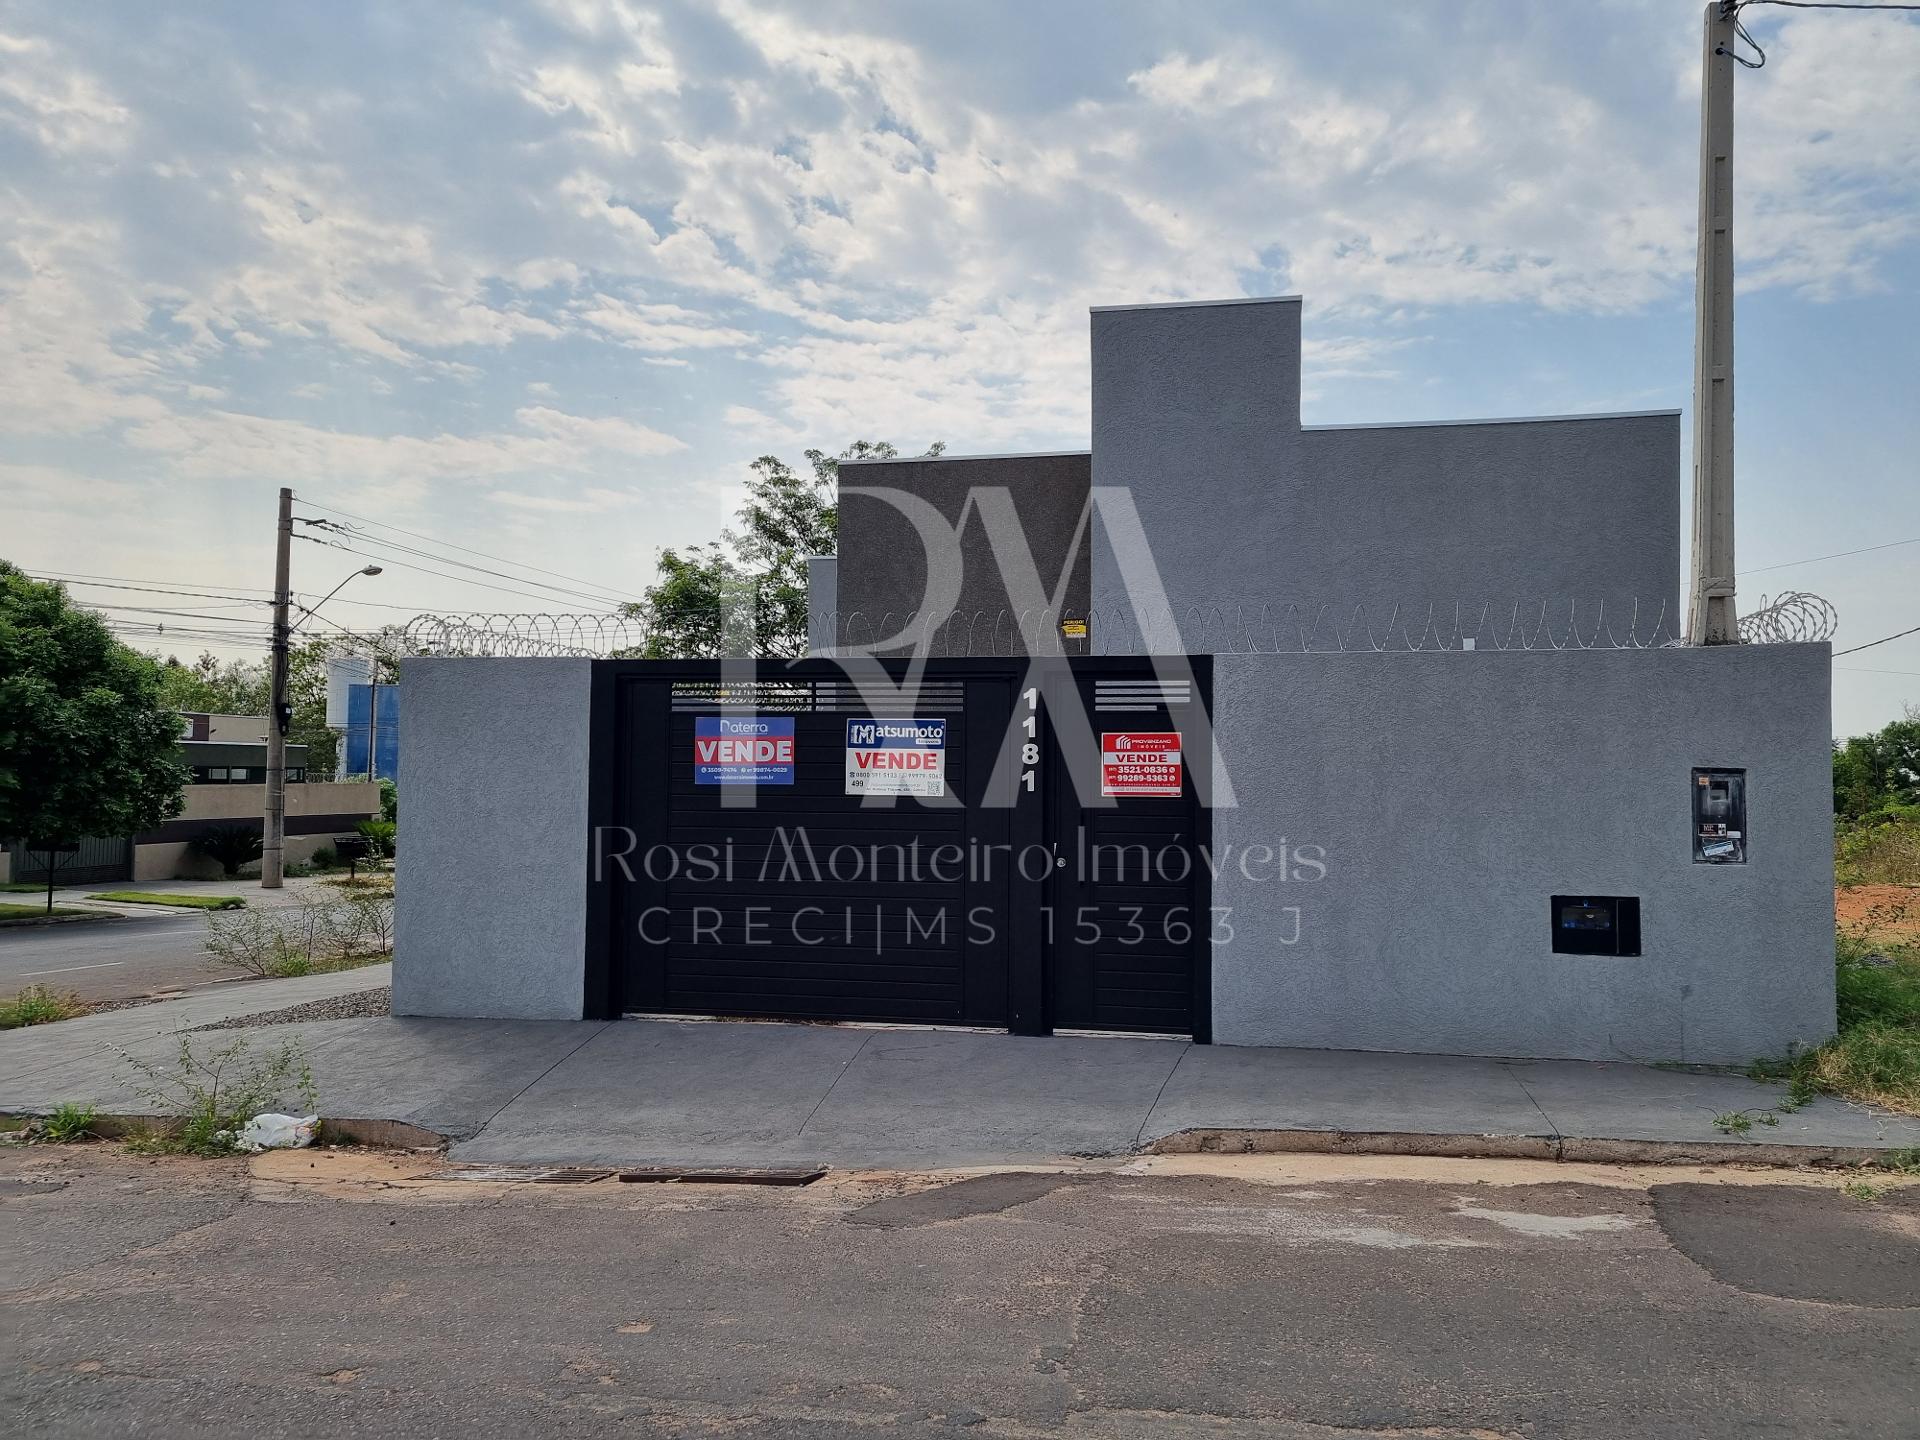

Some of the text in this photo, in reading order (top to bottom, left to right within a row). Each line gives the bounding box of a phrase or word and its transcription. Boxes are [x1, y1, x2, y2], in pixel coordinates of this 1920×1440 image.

[851, 725, 943, 744] Matsumoto
[1021, 687, 1040, 792] 1181
[697, 740, 793, 762] VENDE
[1115, 754, 1168, 763] VENDE
[855, 752, 937, 770] VENDE
[1117, 774, 1168, 782] 99289-5363
